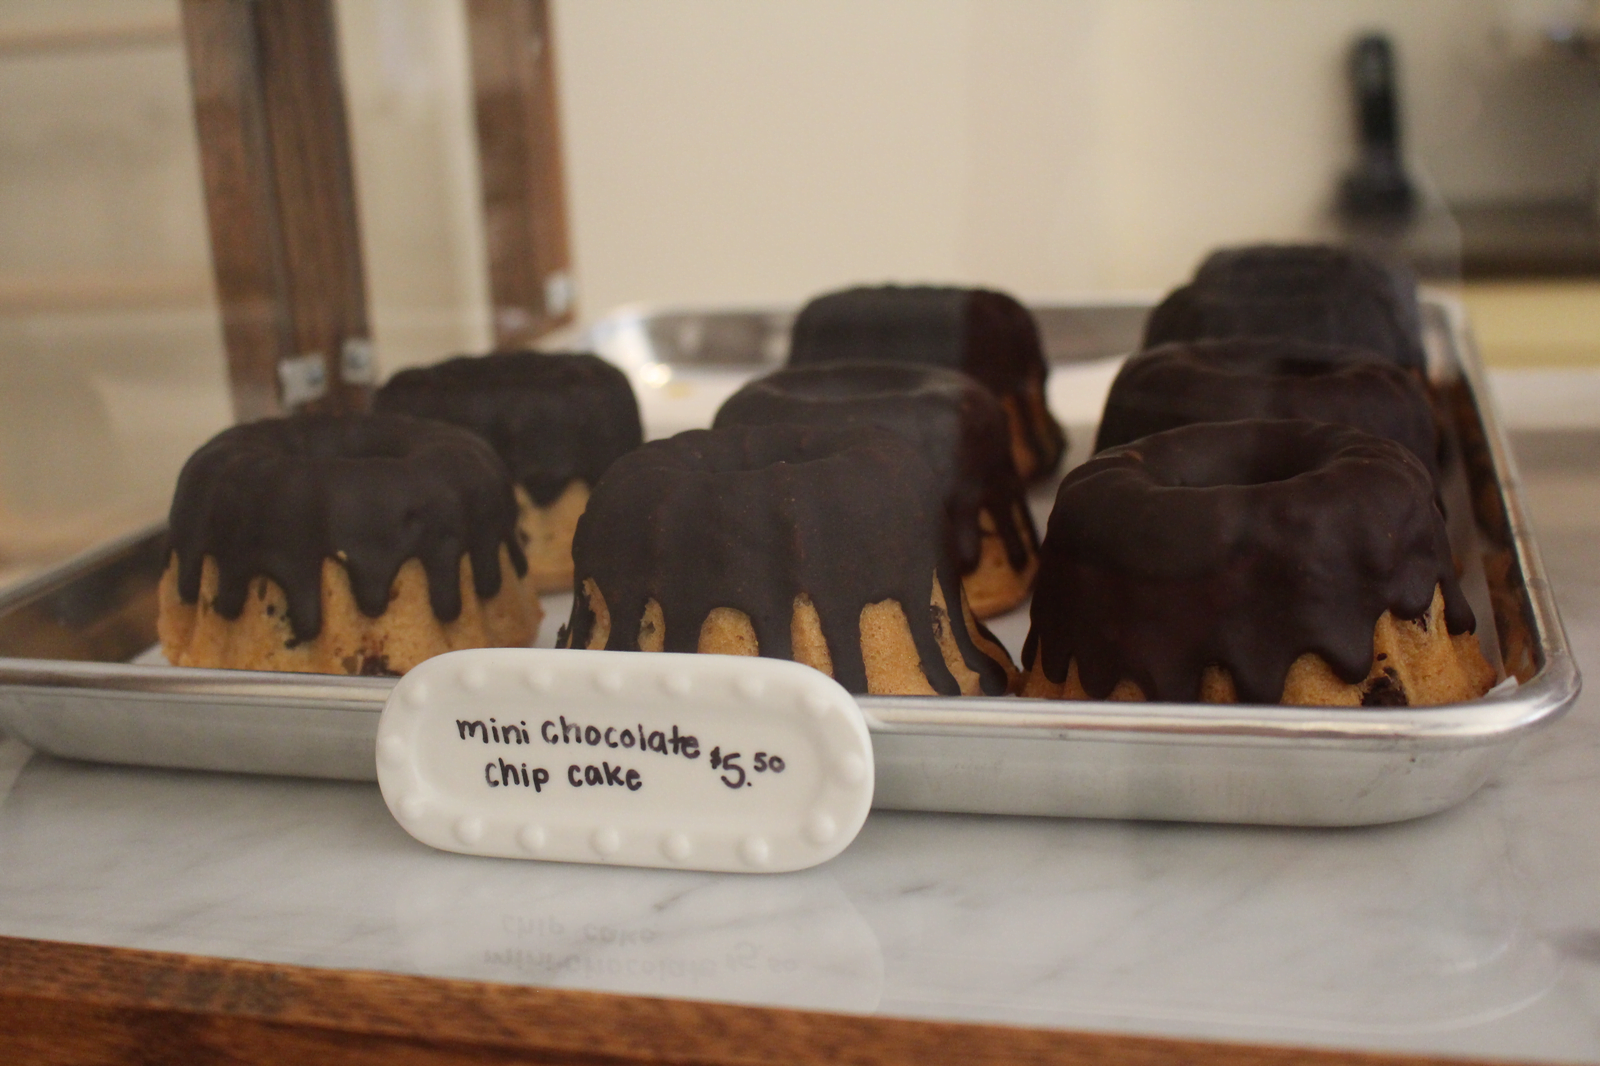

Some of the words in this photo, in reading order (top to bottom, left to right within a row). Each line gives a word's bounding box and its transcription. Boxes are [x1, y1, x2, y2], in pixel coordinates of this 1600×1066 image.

[455, 717, 530, 745] mini
[540, 715, 701, 760] chocolate
[484, 757, 550, 793] chip
[567, 761, 643, 792] cake
